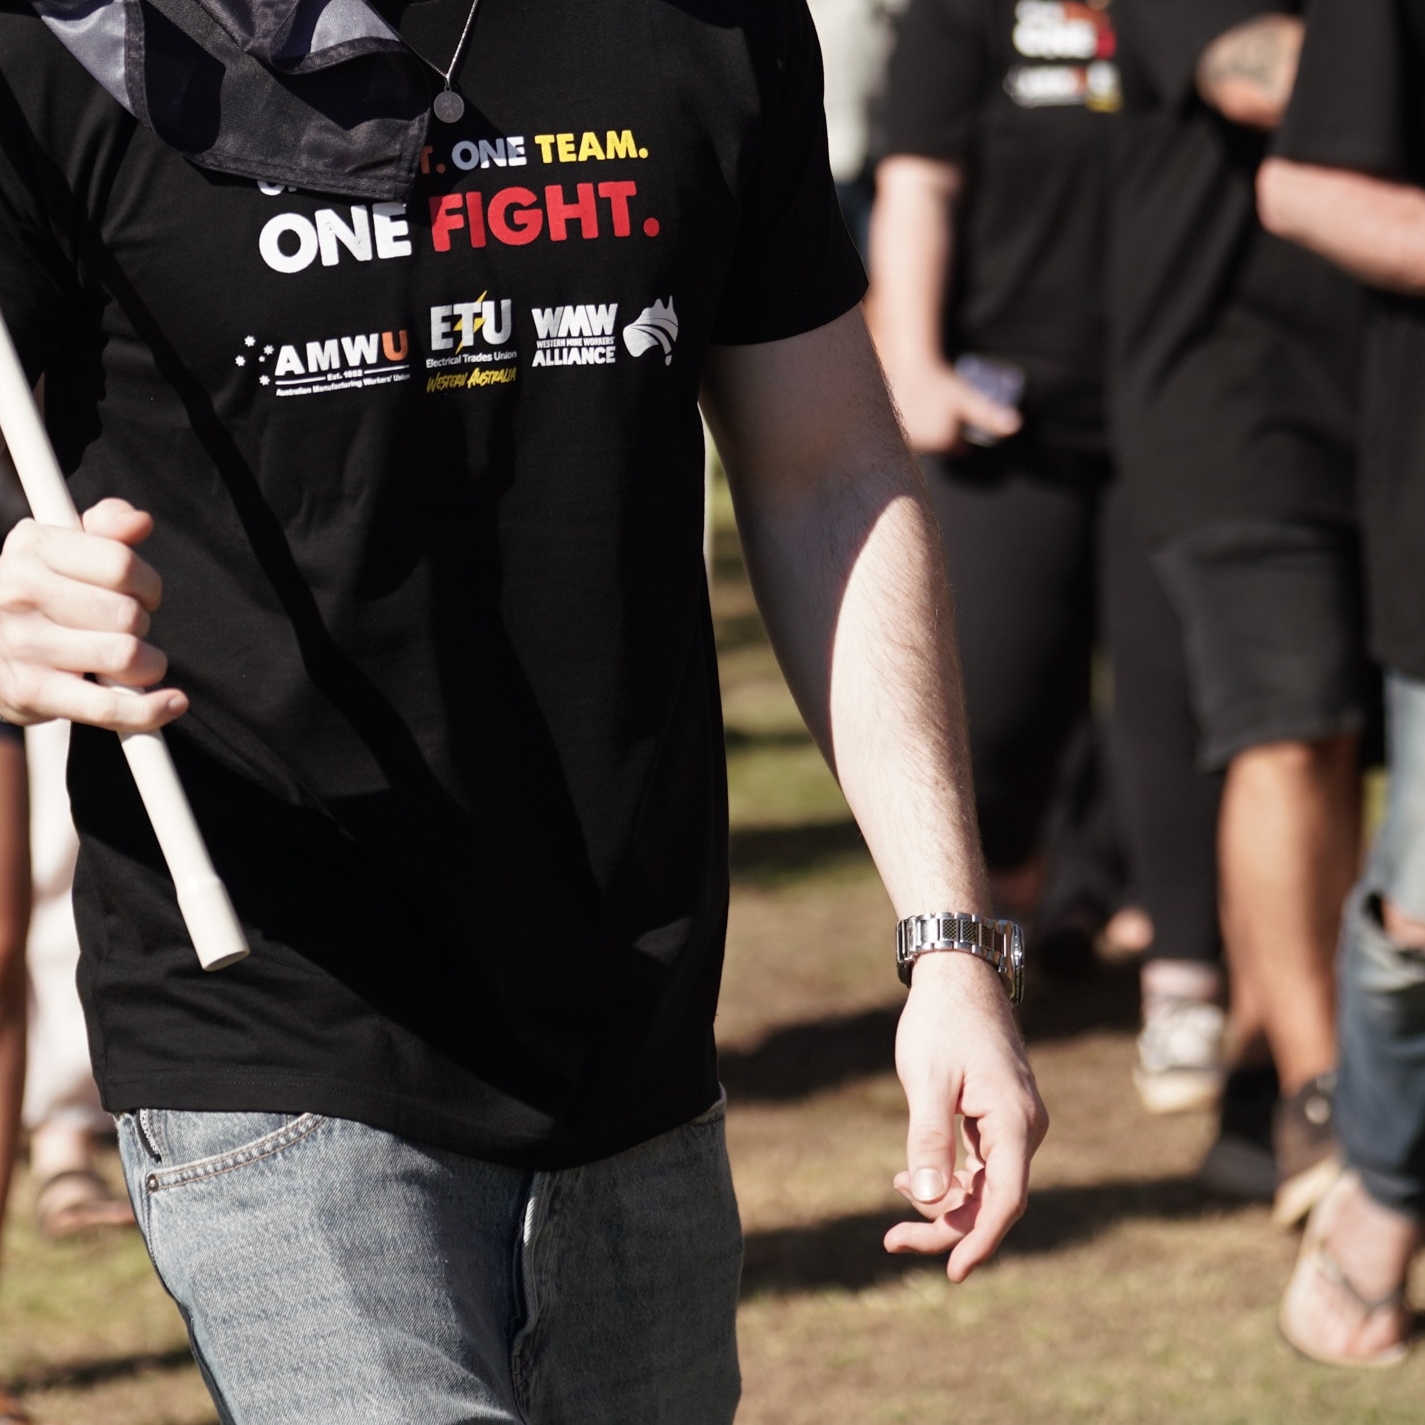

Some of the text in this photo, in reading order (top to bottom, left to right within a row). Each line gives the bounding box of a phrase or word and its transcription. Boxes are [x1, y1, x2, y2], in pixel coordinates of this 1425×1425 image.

[451, 136, 527, 171] ONE
[534, 129, 649, 164] TEAM.
[258, 180, 660, 274] ONE FIGHT.
[430, 299, 512, 351] ETU
[531, 303, 618, 339] WMW
[275, 329, 409, 376] AMWU
[426, 351, 517, 368] Electrical Trades Union
[531, 346, 616, 368] ALLIANCE
[536, 338, 566, 349] WESTERN
[566, 337, 583, 347] MINE
[276, 387, 312, 396] Australian
[312, 380, 363, 393] Manufacturing
[393, 373, 411, 382] Union
